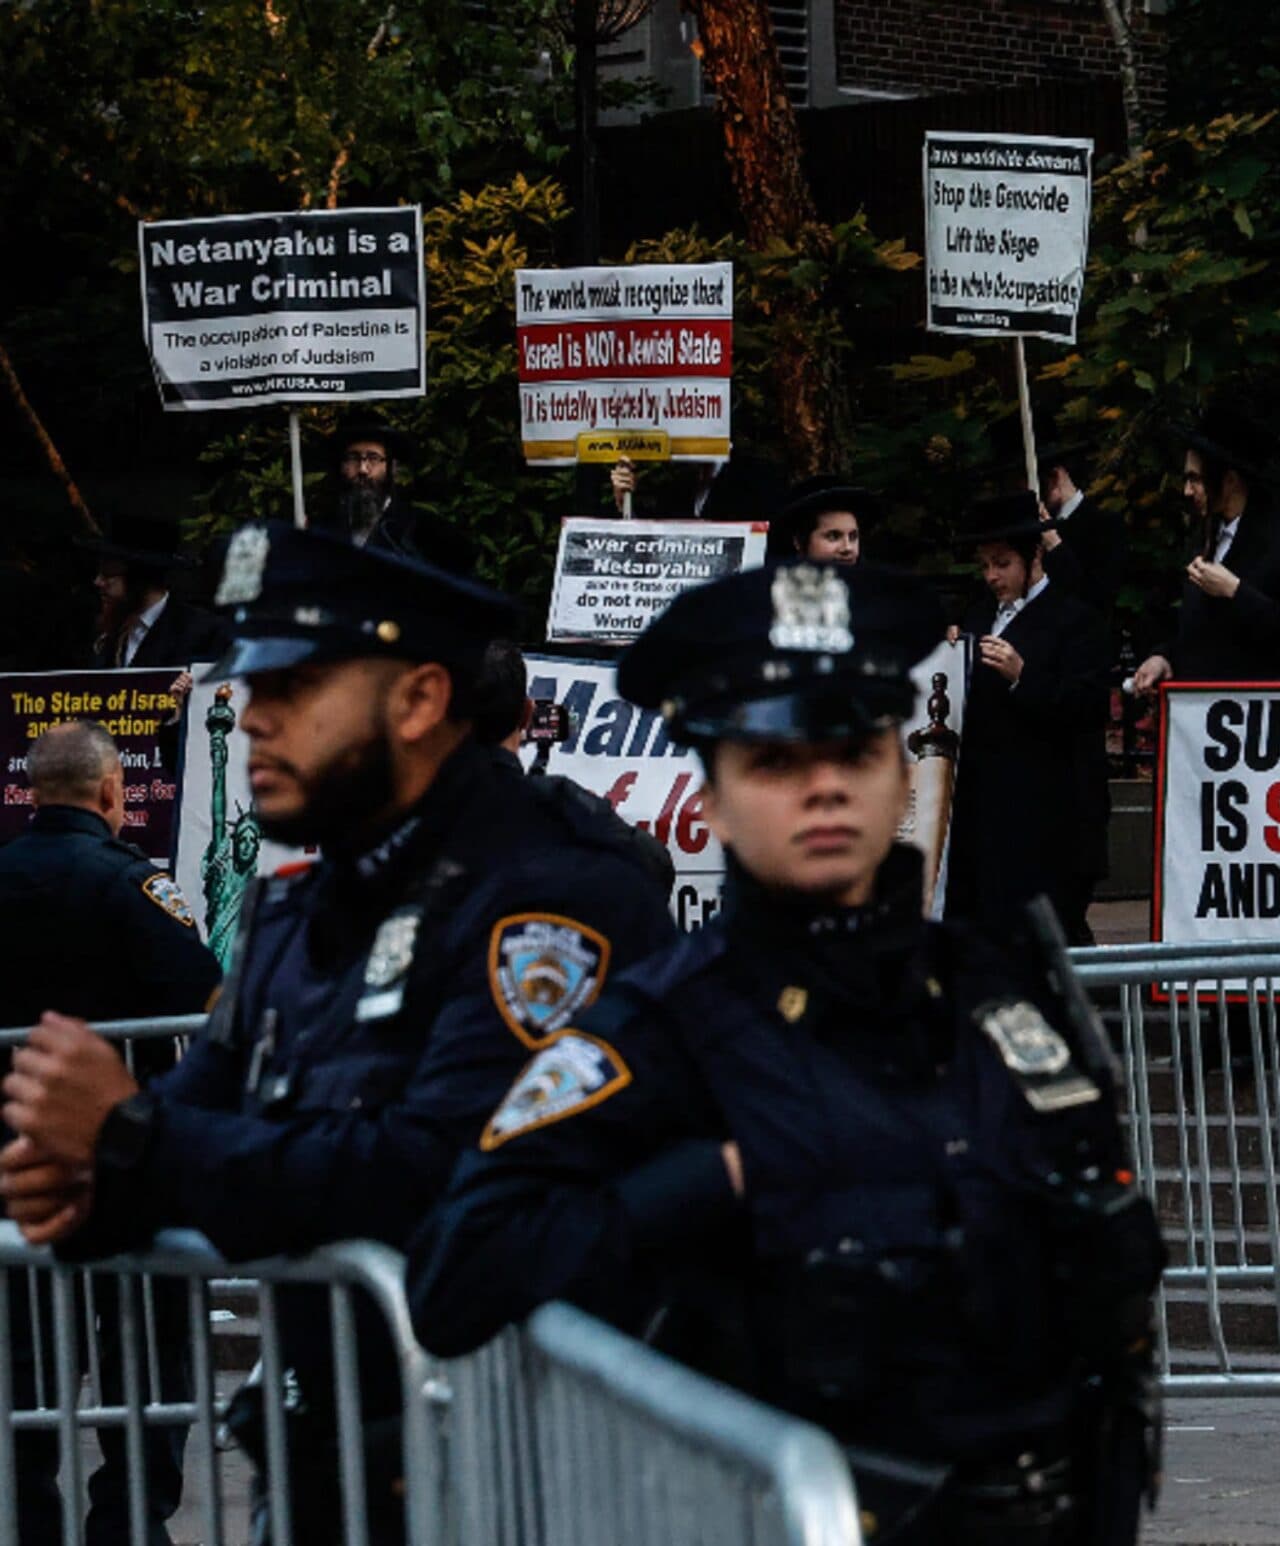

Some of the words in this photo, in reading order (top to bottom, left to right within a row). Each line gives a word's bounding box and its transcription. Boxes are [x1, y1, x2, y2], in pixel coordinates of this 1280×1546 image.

[934, 180, 965, 212] Stop
[969, 182, 991, 208] the
[996, 183, 1069, 213] Genocide
[151, 230, 335, 267] Netanyahu
[349, 229, 377, 253] is
[388, 232, 410, 253] a
[946, 226, 972, 253] Lift
[974, 227, 995, 254] the
[999, 228, 1039, 262] Siege
[172, 280, 241, 308] War
[252, 269, 391, 300] Criminal
[521, 284, 544, 313] The
[547, 279, 587, 311] world
[588, 280, 621, 309] must
[625, 276, 689, 315] recognize
[692, 276, 724, 306] that
[164, 332, 196, 348] The
[200, 323, 287, 347] occupation
[291, 321, 308, 338] of
[313, 322, 391, 337] Palestine
[395, 321, 409, 335] is
[523, 333, 564, 370] Israel
[566, 333, 582, 368] is
[585, 330, 616, 367] NOT
[628, 329, 674, 366] Jewish
[677, 328, 722, 365] State
[200, 360, 210, 372] a
[215, 352, 277, 371] violation
[282, 350, 300, 365] of
[302, 349, 375, 365] Judaism
[536, 393, 548, 423] is
[551, 389, 597, 428] totally
[663, 386, 722, 419] Judaism
[635, 539, 724, 555] criminal
[593, 557, 711, 578] Netanyahu
[577, 593, 598, 607] do
[603, 593, 631, 607] not
[594, 613, 643, 629] World
[12, 692, 45, 714] The
[51, 691, 102, 713] State
[107, 690, 127, 710] of
[130, 690, 178, 711] Israe
[1201, 779, 1249, 851] IS
